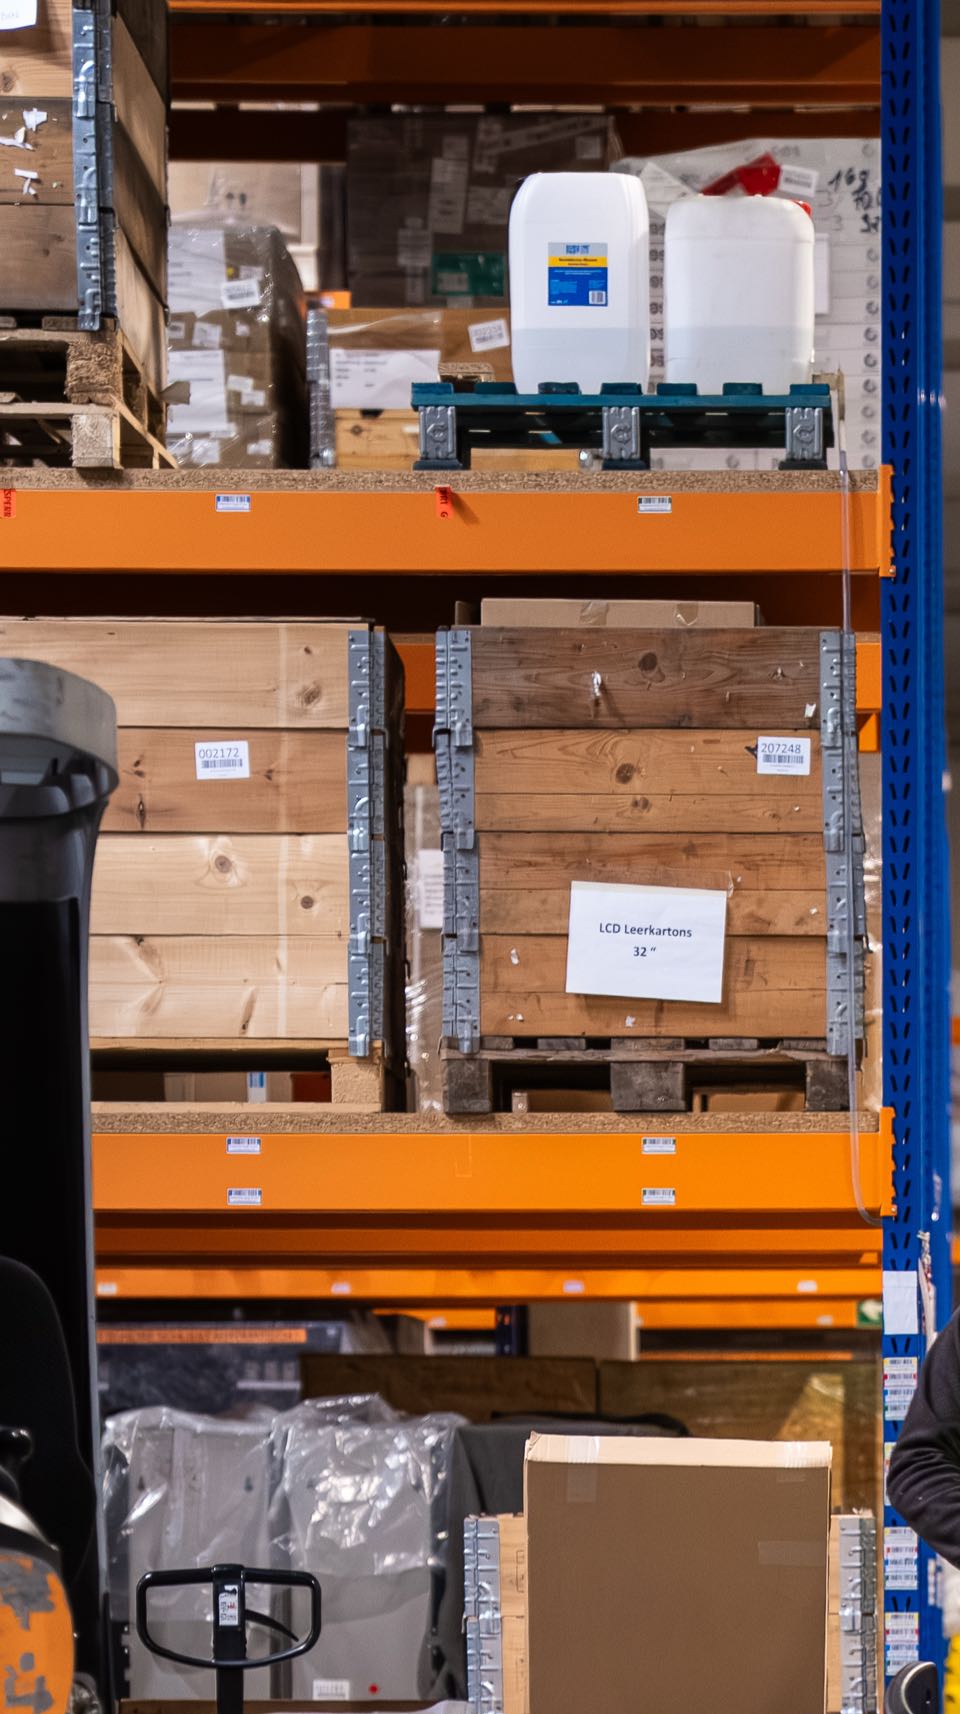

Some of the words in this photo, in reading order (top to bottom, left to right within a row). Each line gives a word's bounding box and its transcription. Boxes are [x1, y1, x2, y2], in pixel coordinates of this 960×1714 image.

[198, 747, 240, 759] 002172
[760, 742, 801, 754] 207248
[599, 922, 621, 934] LCD
[624, 924, 693, 938] Leerkartons
[633, 946, 648, 957] 32
